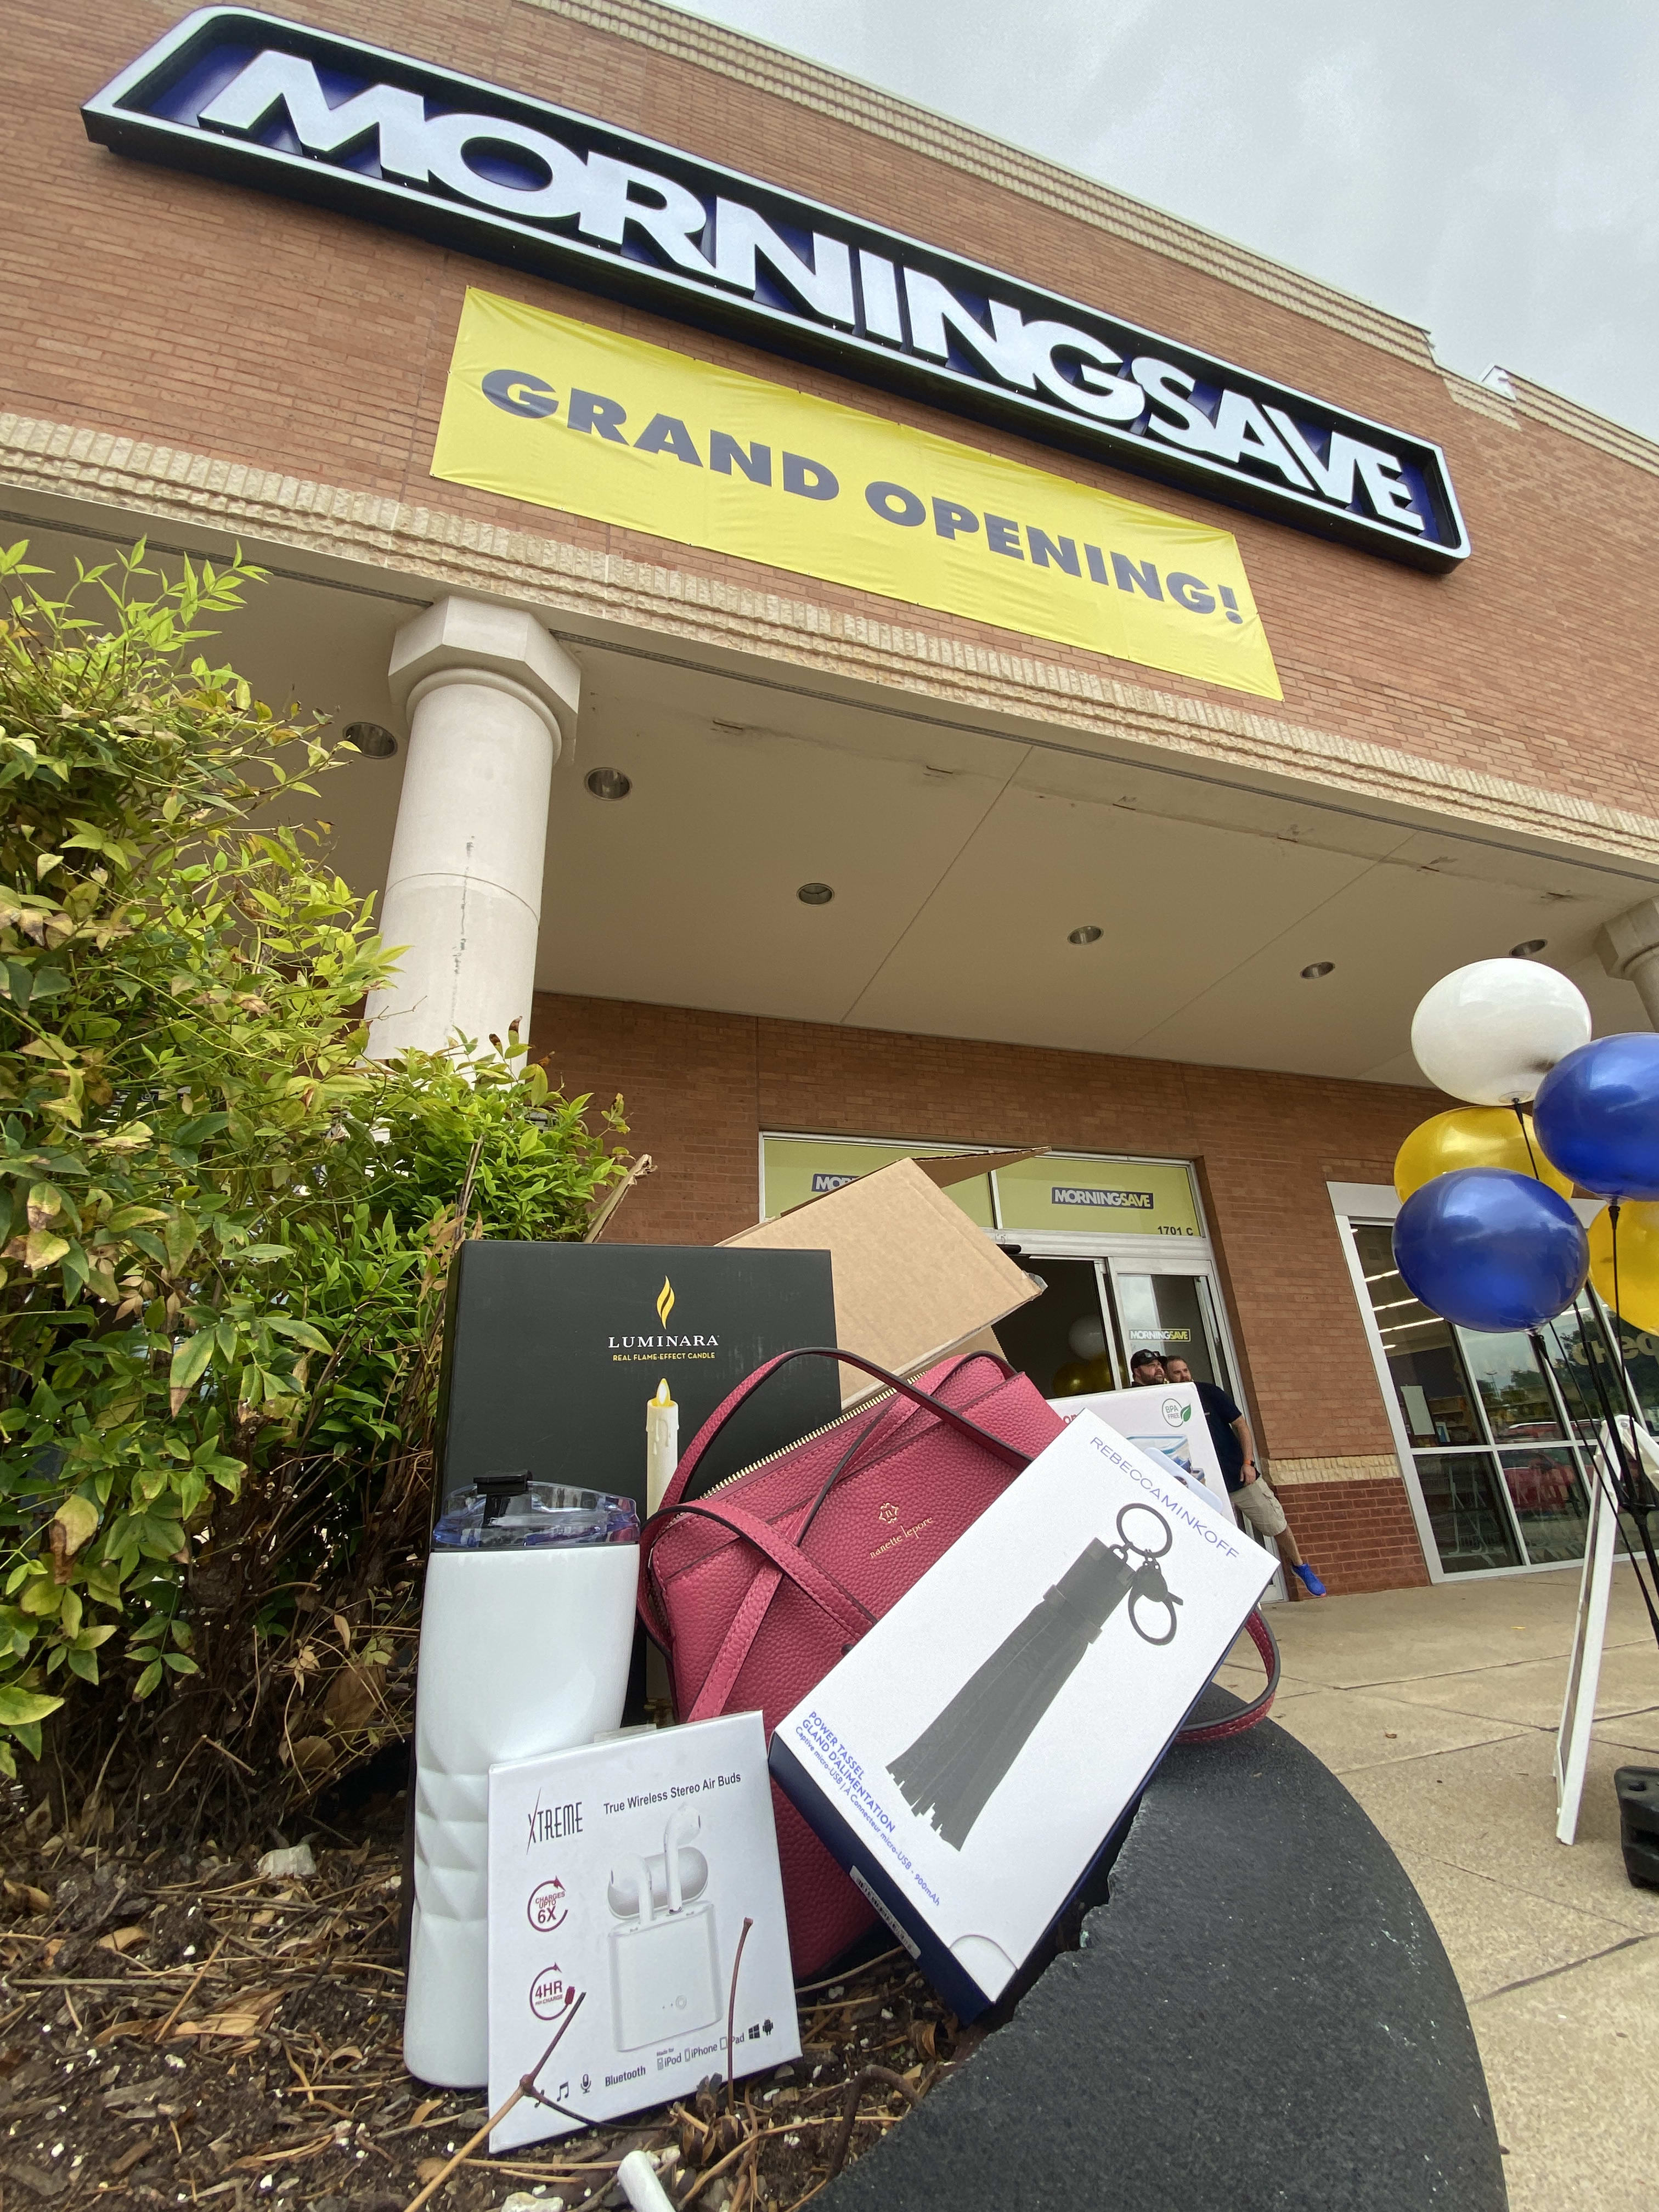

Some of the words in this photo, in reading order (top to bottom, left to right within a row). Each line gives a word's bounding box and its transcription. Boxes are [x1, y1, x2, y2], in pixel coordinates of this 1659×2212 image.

[201, 49, 1425, 532] MORNINGSAVE
[482, 369, 840, 501] GRAND
[865, 481, 1244, 625] OPENING!
[1054, 1189, 1151, 1207] MORNINGSAVE
[1157, 1226, 1182, 1235] 1701
[1186, 1227, 1193, 1236] C
[607, 1335, 719, 1348] LUMINARA
[1130, 1330, 1188, 1340] MORNINGSAVE
[1165, 1404, 1179, 1413] BPA
[1090, 1436, 1239, 1558] REBECCAMINKOFF
[869, 1535, 902, 1558] nanette
[900, 1516, 933, 1539] lepore
[809, 1711, 838, 1747] POWER
[837, 1743, 865, 1781] TASSEL
[802, 1719, 830, 1752] GLAND
[828, 1751, 896, 1833] D'ALIMENTATION
[603, 1802, 625, 1815] True
[627, 1792, 668, 1809] Wireless
[670, 1784, 700, 1799] Stereo
[702, 1778, 715, 1791] Air
[718, 1773, 741, 1787] Buds
[527, 1787, 583, 1855] XTREME
[795, 1726, 816, 1752] Captive
[814, 1750, 843, 1785] micro-USB
[850, 1795, 882, 1833] Connecteur
[880, 1832, 912, 1870] micro-USB
[913, 1873, 940, 1907] 900mAh
[535, 1891, 566, 1904] CHARGES
[538, 1906, 556, 1924] 6X
[535, 1980, 562, 1999] 4HR
[664, 2052, 681, 2067] iPod
[691, 2043, 718, 2059] iPhone
[605, 2065, 646, 2087] Bluetooth
